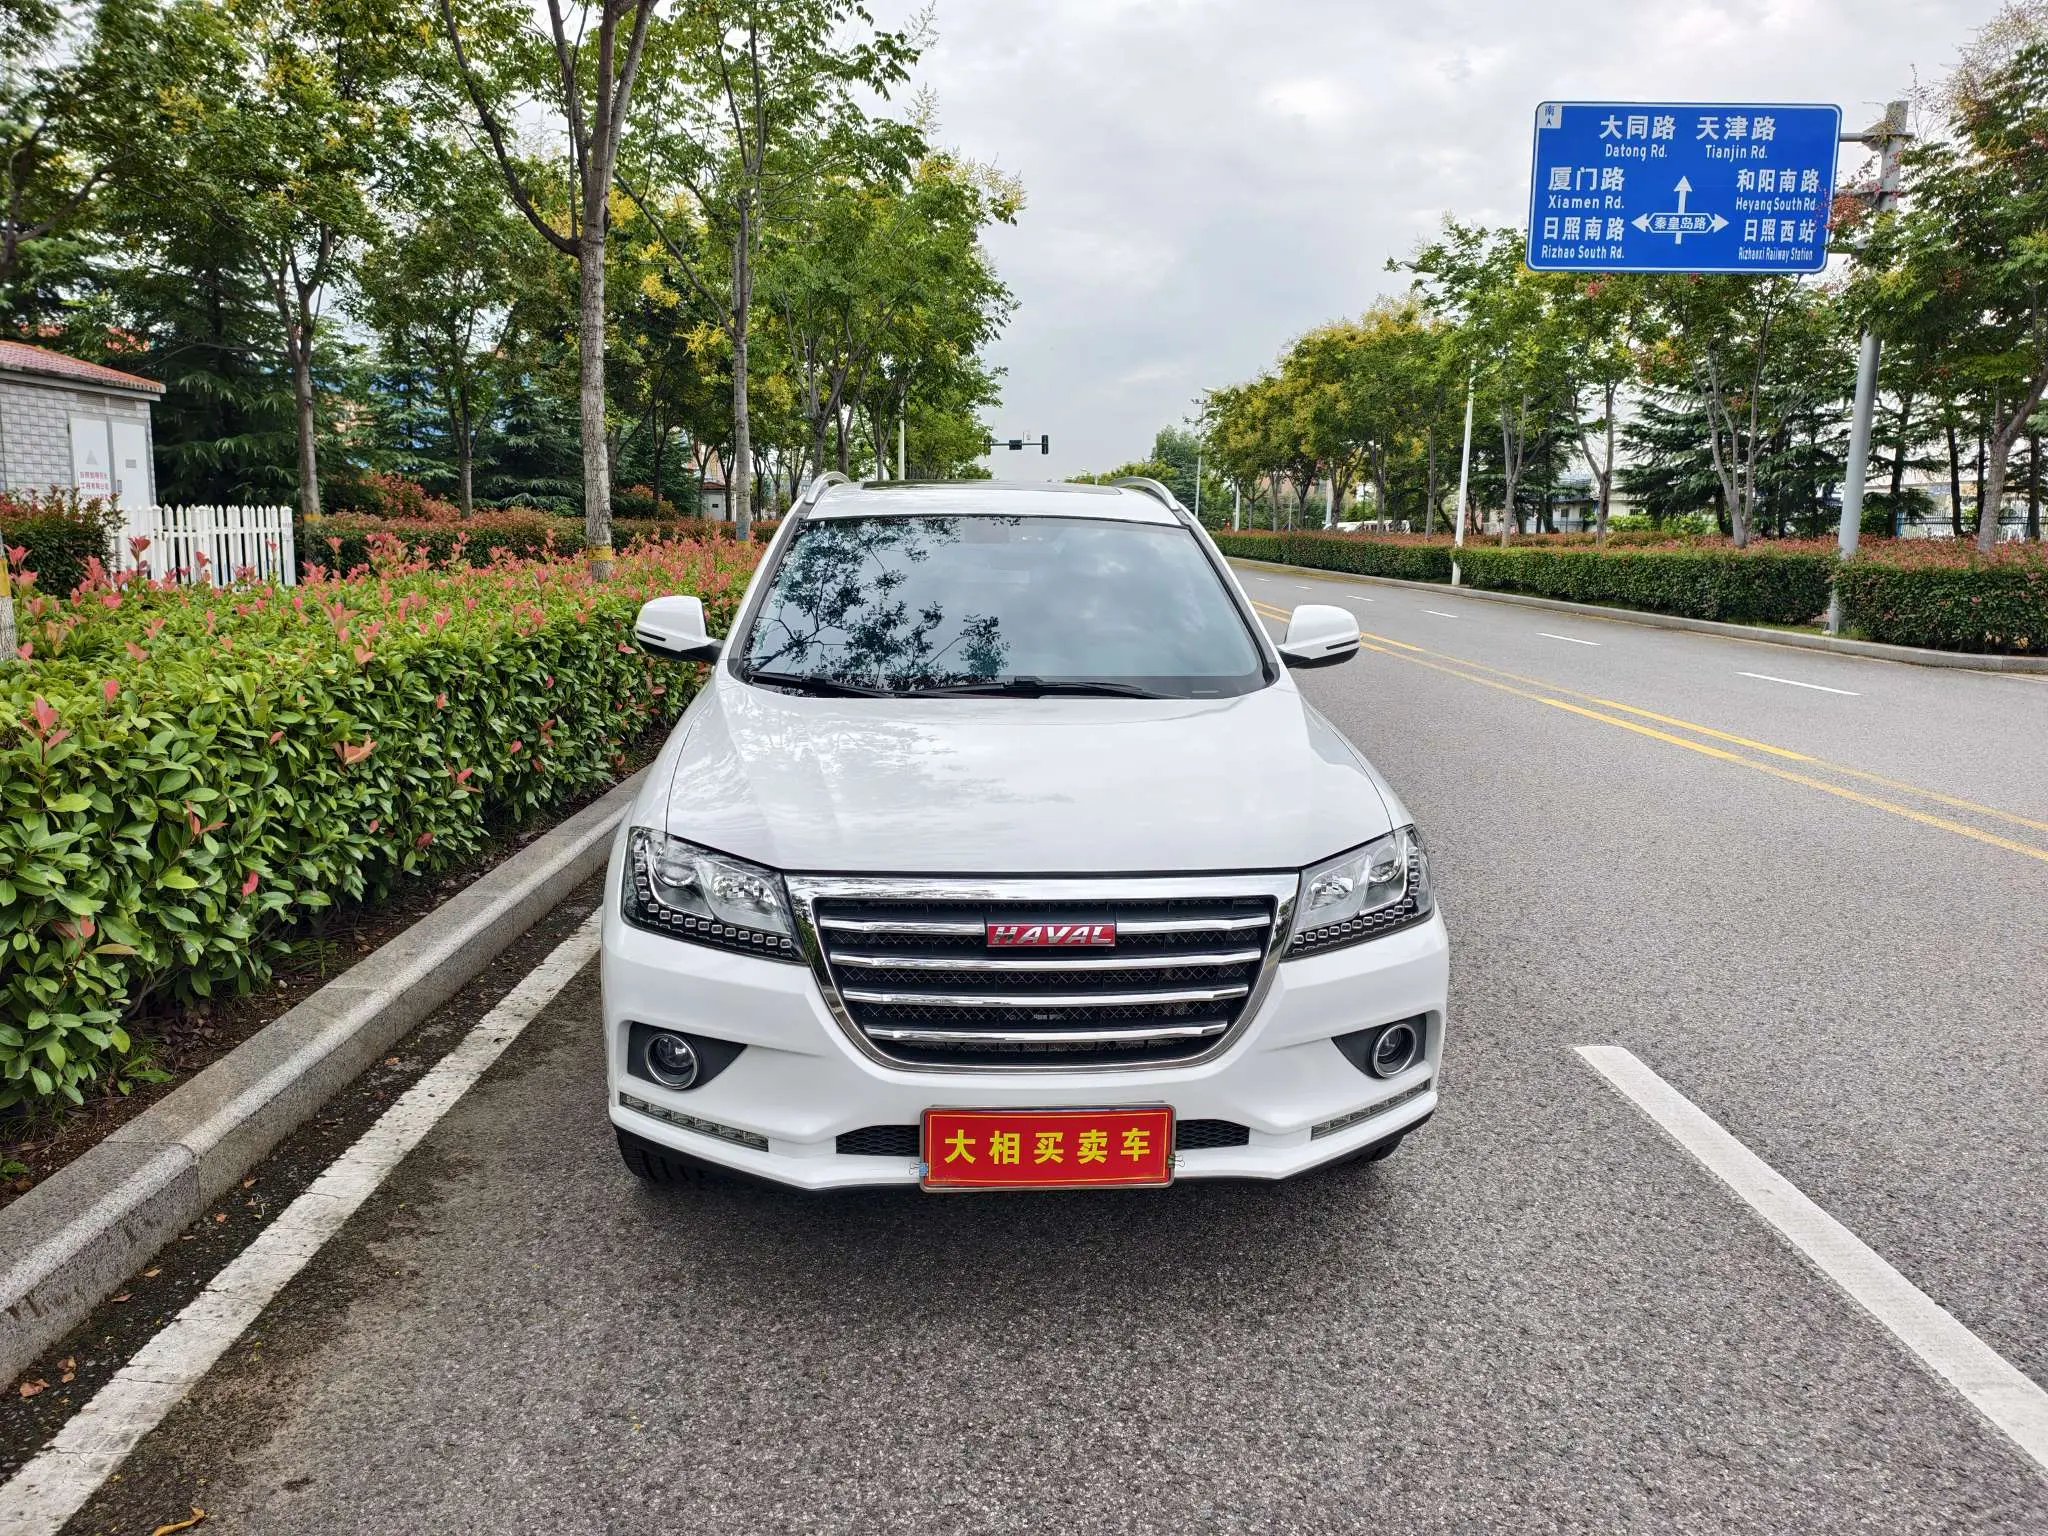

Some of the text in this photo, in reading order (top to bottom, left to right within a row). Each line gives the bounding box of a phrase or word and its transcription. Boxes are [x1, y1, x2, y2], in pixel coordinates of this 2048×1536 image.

[1599, 115, 1676, 140] 大同路
[1696, 115, 1776, 141] 天津路
[1605, 143, 1668, 162] Datong Rd.
[1705, 145, 1768, 162] Tianjin Rd.
[1548, 166, 1625, 191] 厦门路
[1736, 168, 1819, 194] 和阳南路
[1547, 194, 1625, 209] Xiamen Rd.
[1735, 196, 1773, 215] Heyang
[1773, 197, 1802, 211] South
[1543, 216, 1625, 242] 日照南路
[1654, 216, 1707, 230] 秦皇岛路
[1744, 218, 1817, 243] 日照西站
[1541, 244, 1625, 259] Rizhao South Rd.
[1765, 246, 1790, 264] Railway
[1790, 247, 1813, 261] Station
[992, 926, 1112, 944] HAVAL
[944, 1127, 1151, 1165] 大相买卖车
